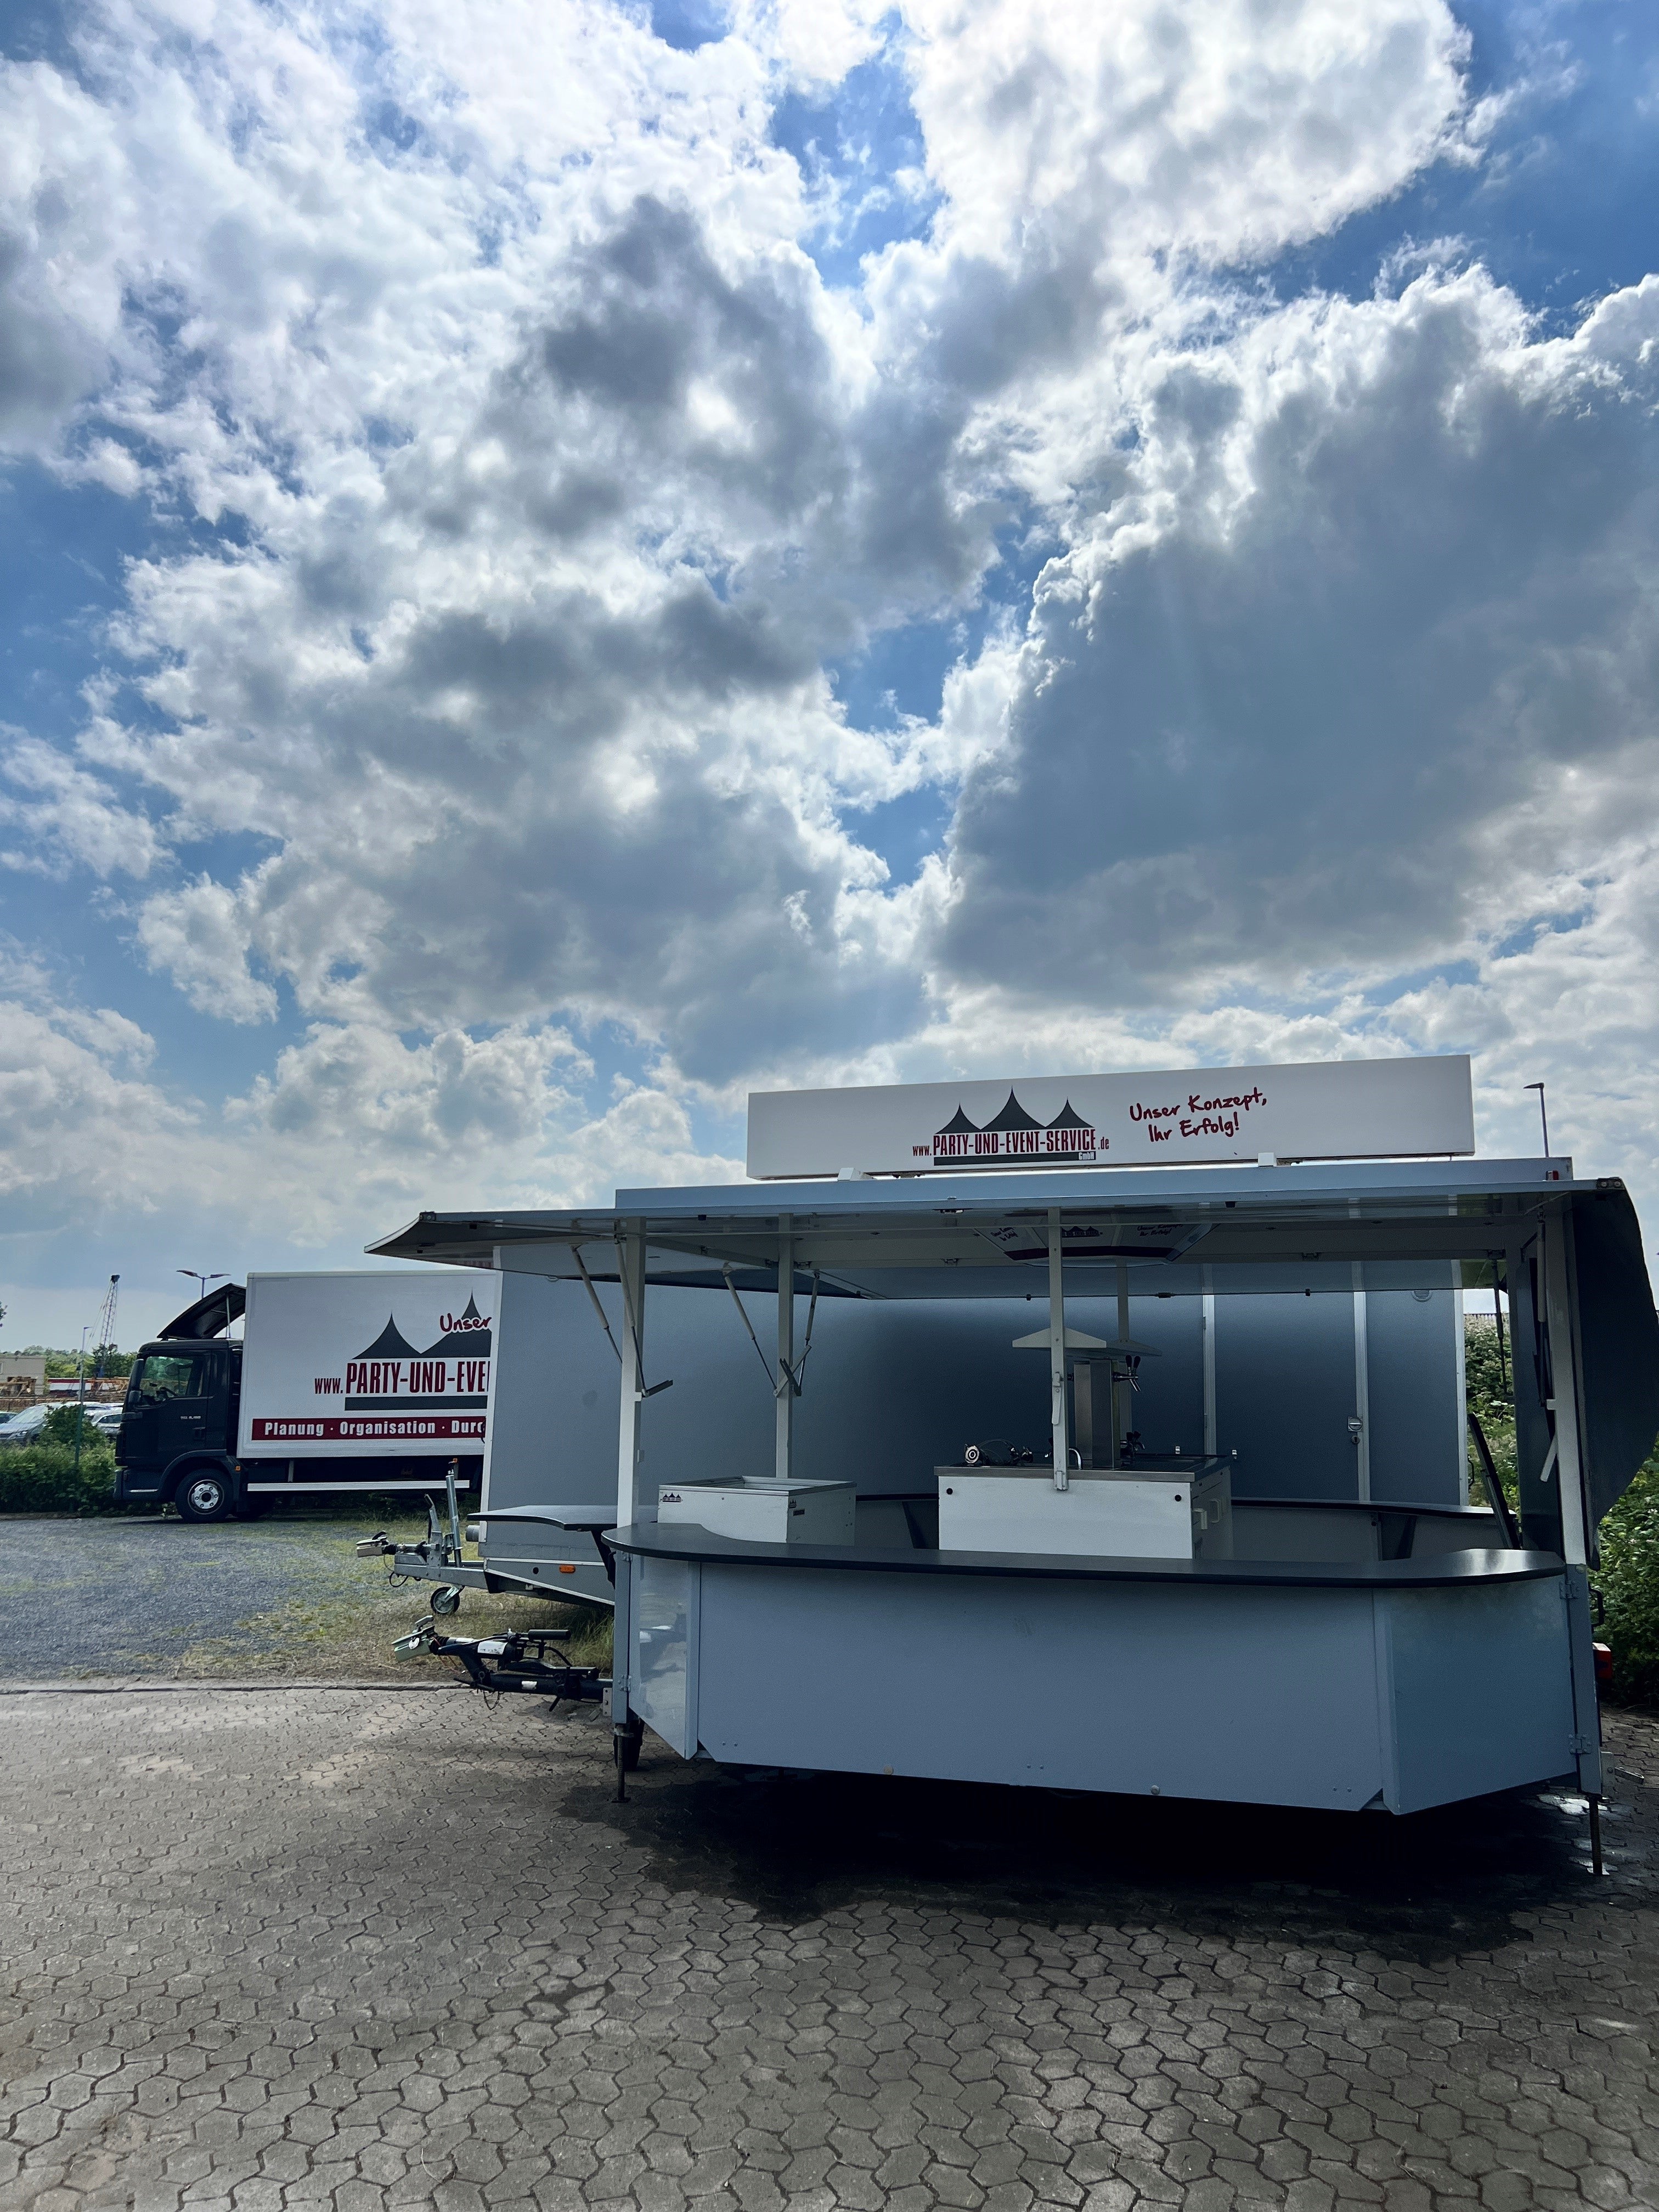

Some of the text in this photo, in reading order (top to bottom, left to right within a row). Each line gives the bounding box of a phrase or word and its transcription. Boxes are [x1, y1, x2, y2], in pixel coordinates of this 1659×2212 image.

[1130, 1087, 1267, 1121] Unser Konzept,
[1148, 1111, 1239, 1142] Ihr Erfolg!
[1078, 1152, 1094, 1160] GmbH
[440, 1313, 492, 1332] Unser
[314, 1361, 490, 1394] www.PARTY-UND-EVE
[264, 1422, 324, 1436] Planung
[340, 1420, 436, 1436] Organisation
